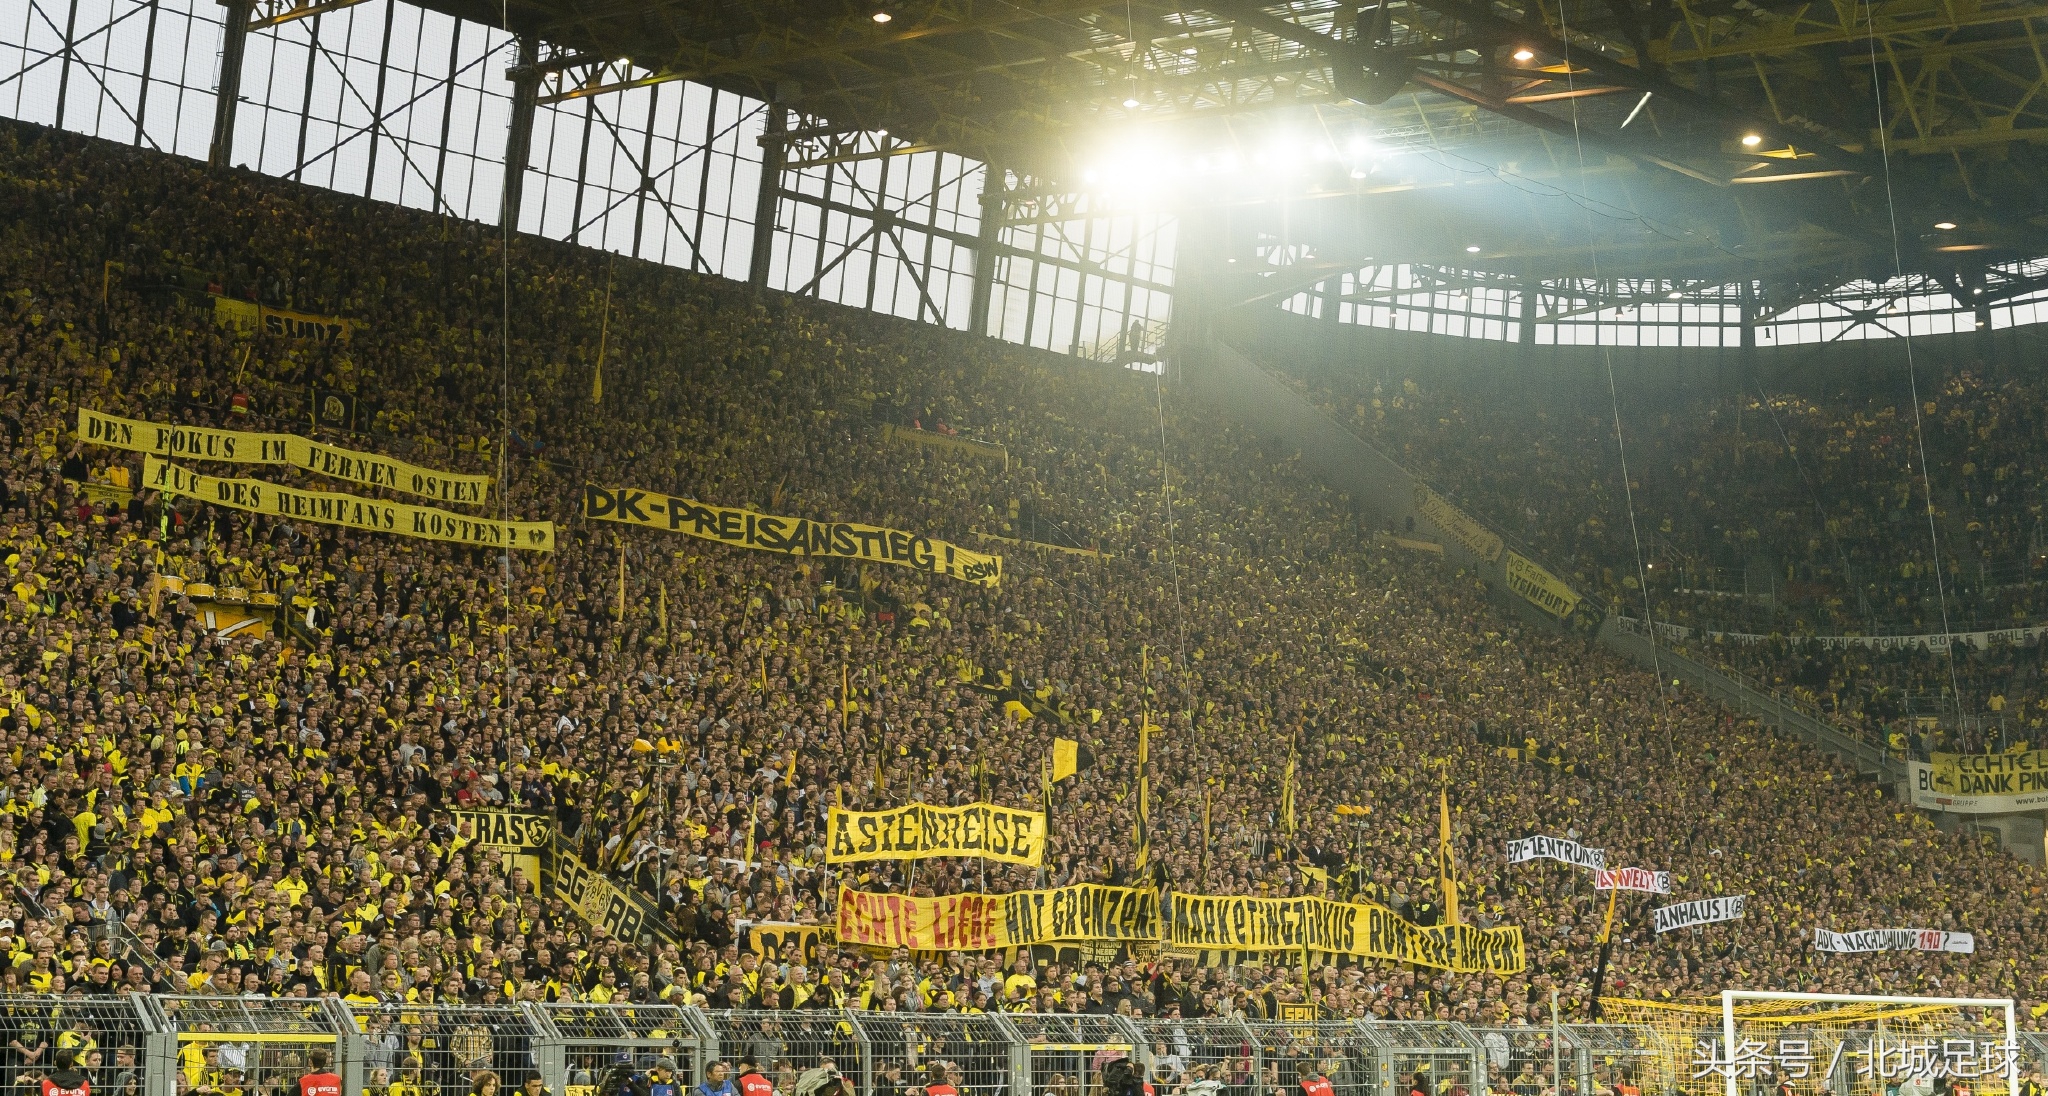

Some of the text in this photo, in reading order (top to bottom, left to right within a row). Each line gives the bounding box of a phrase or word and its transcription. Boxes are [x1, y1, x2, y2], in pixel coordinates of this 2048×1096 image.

[88, 416, 482, 502] DEN FOKUS IM FERNEN OSTEN
[218, 481, 261, 508] DES
[277, 491, 395, 529] HEIMFANS
[1960, 773, 2014, 793] DANK
[1005, 893, 1045, 945] HAT
